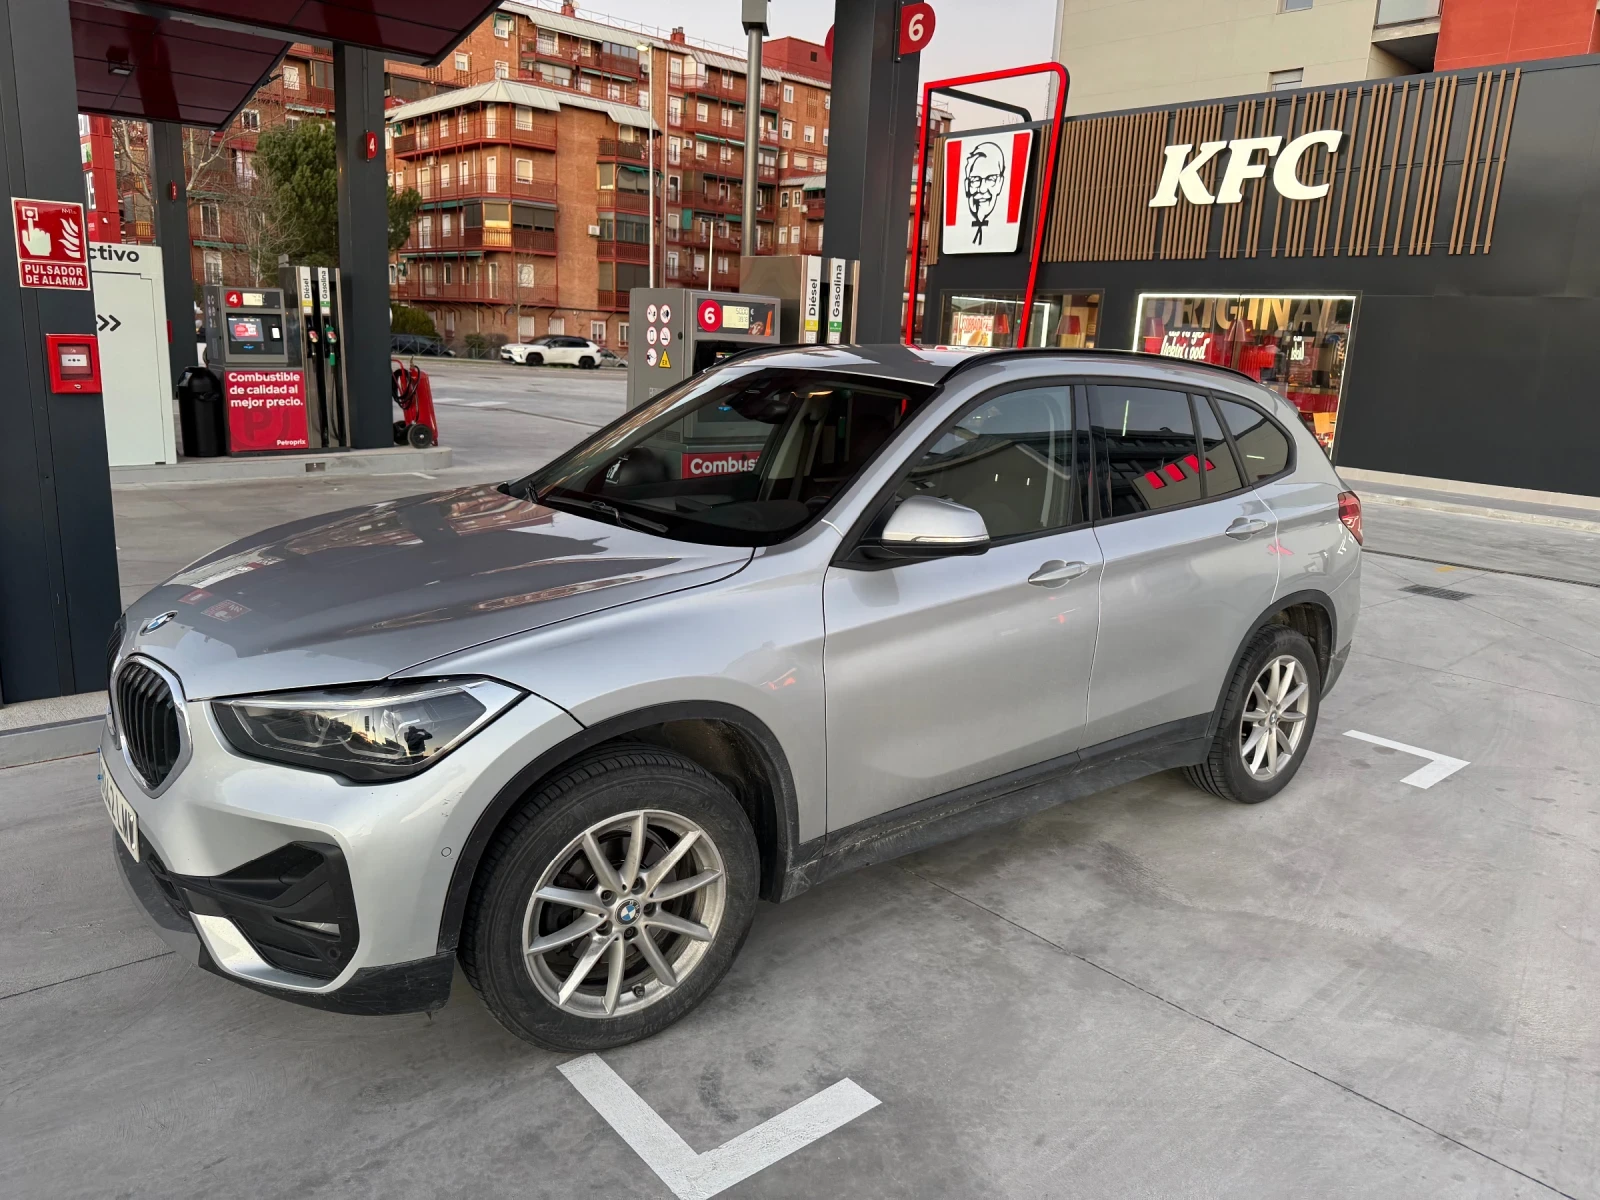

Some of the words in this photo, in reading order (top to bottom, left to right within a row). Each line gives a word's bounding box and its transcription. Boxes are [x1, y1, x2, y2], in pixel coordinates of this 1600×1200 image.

[908, 13, 925, 42] 6
[369, 137, 376, 152] 4
[1148, 129, 1343, 207] KFC
[24, 264, 83, 277] PULSADOR
[25, 275, 40, 284] DE
[42, 275, 84, 286] ALARMA
[808, 278, 818, 316] Diésel
[832, 264, 842, 317] Gasolina
[229, 294, 238, 304] 4
[704, 307, 716, 325] 6
[228, 372, 300, 382] Combustible
[229, 385, 245, 395] de
[246, 384, 287, 395] calidad
[288, 384, 298, 394] al
[230, 397, 264, 409] mejor
[266, 396, 304, 409] precio.
[276, 438, 306, 447] Petroprix
[690, 456, 760, 475] Combus
